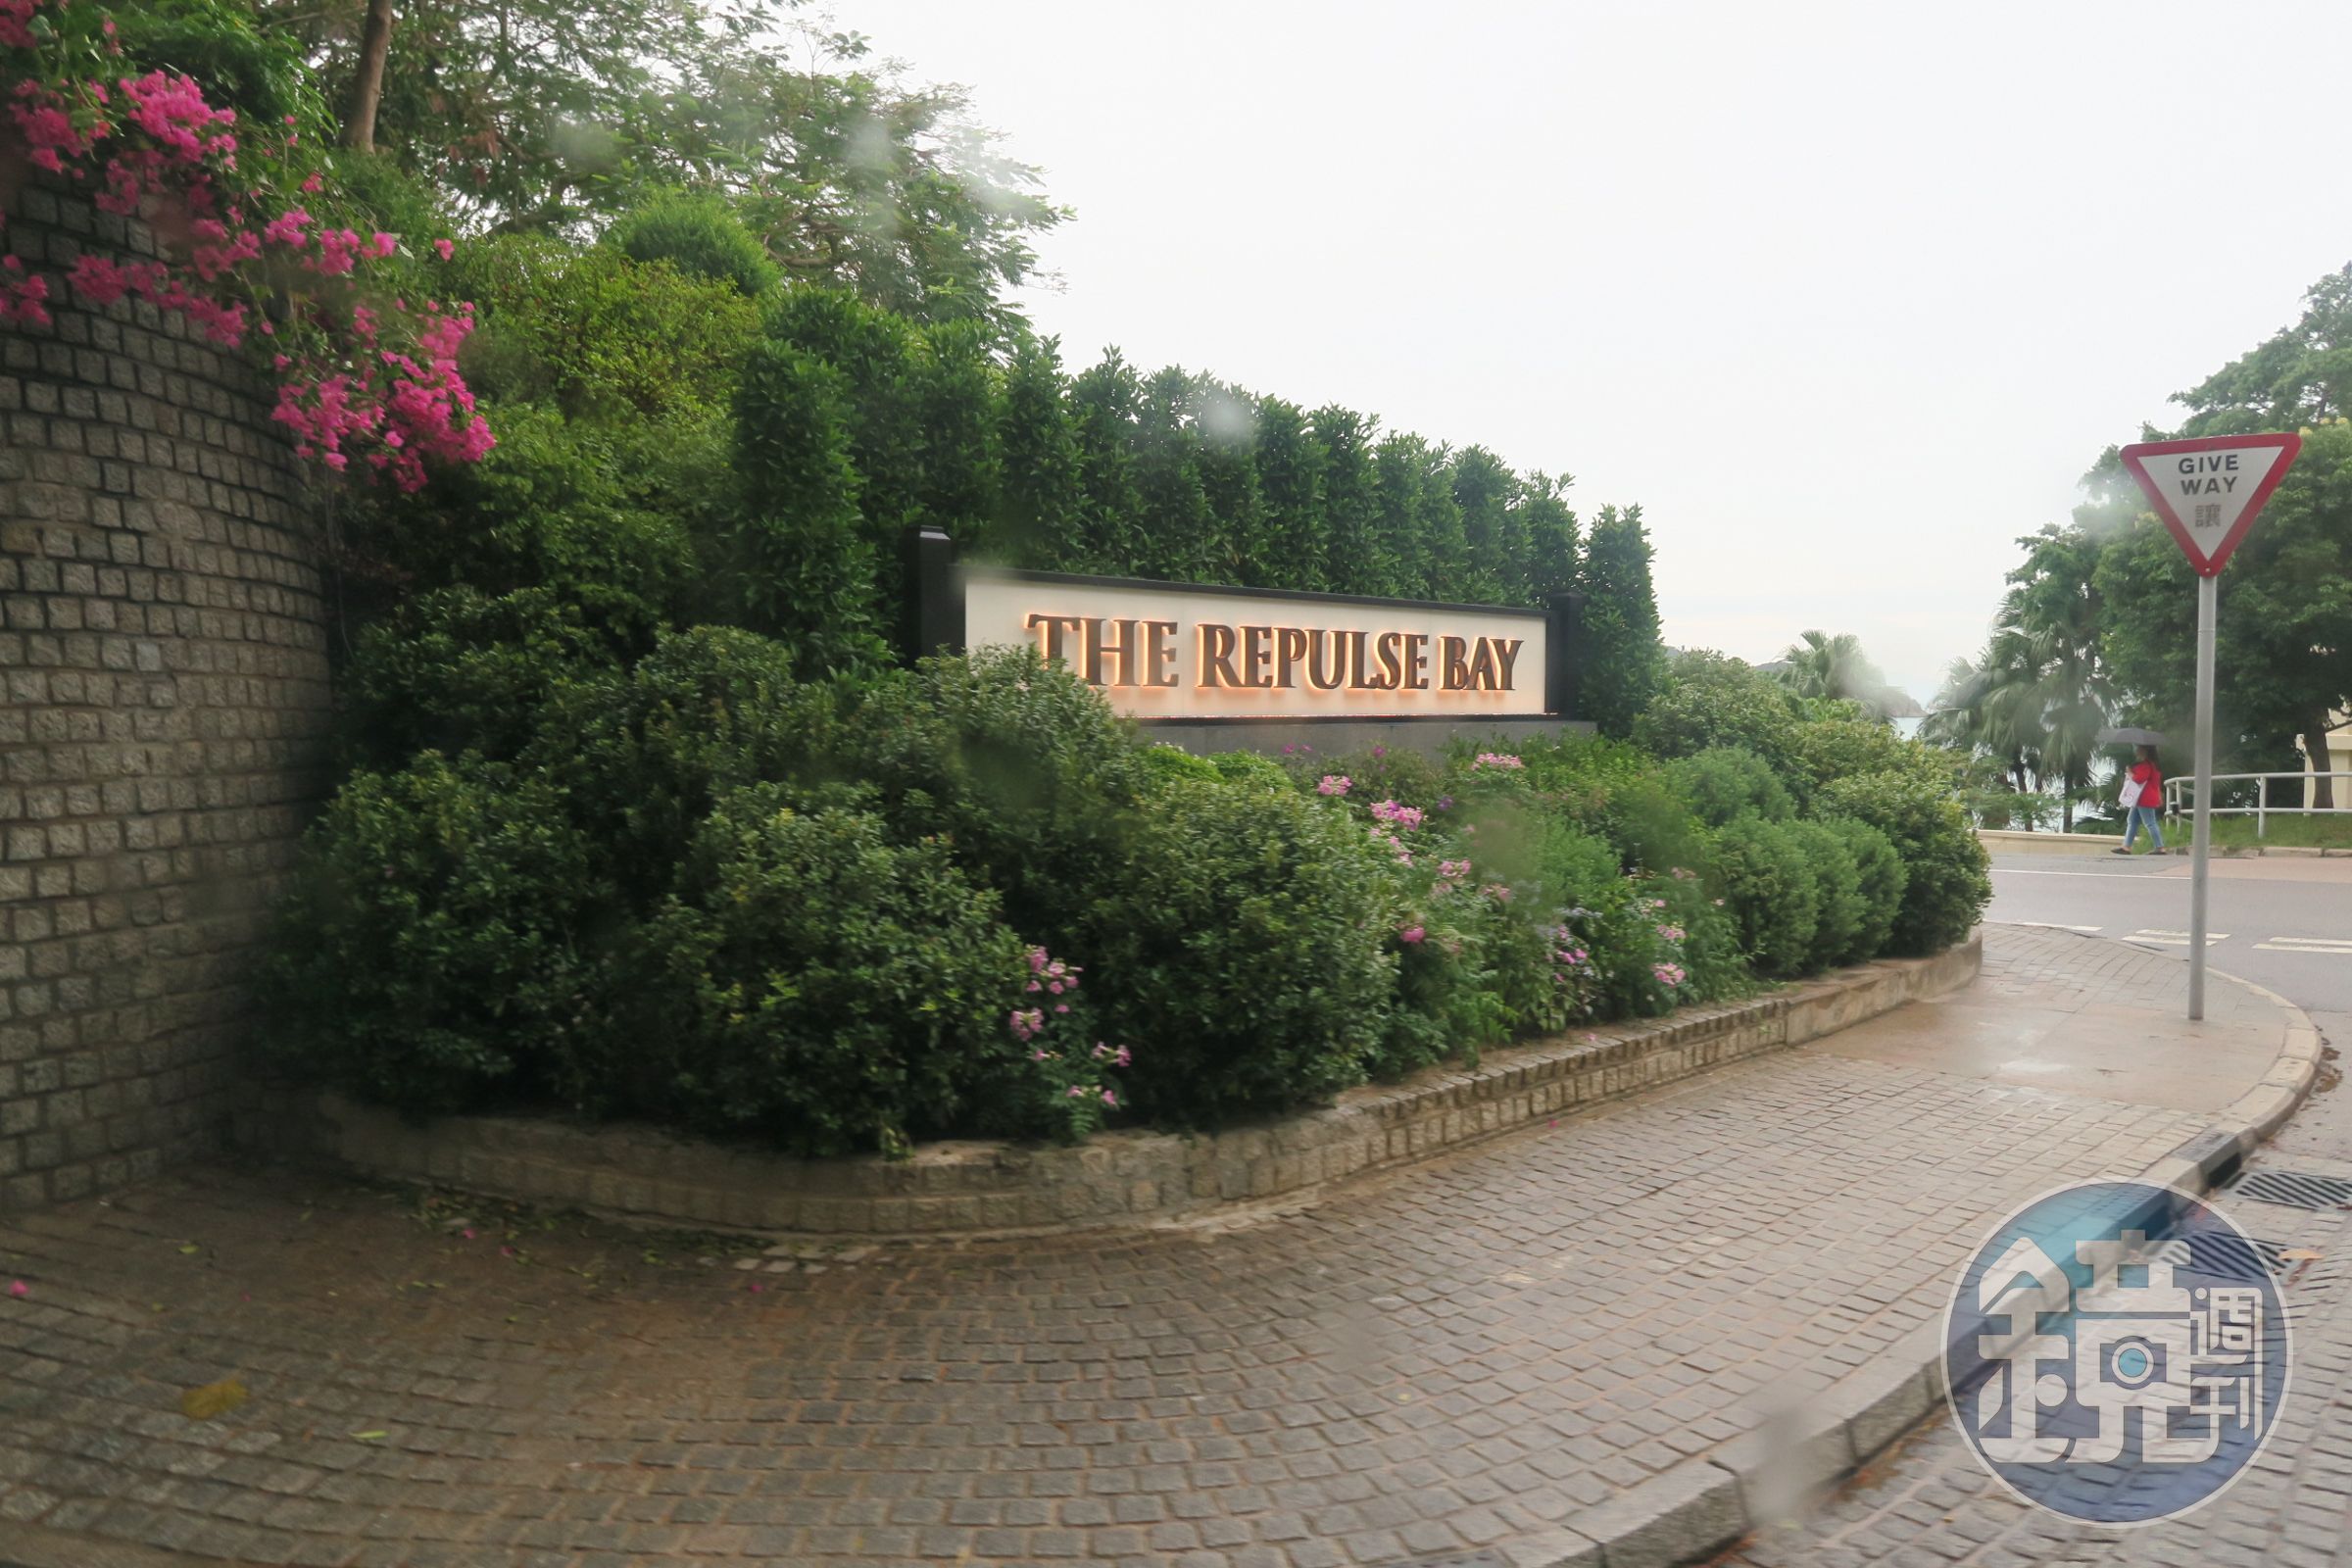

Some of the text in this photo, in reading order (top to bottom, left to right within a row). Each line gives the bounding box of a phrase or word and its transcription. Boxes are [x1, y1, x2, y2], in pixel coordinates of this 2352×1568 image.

[2178, 454, 2239, 474] GIVE
[2180, 476, 2238, 495] WAY
[2194, 504, 2222, 528] 讓
[1027, 612, 1525, 691] THE REPULSE BAY
